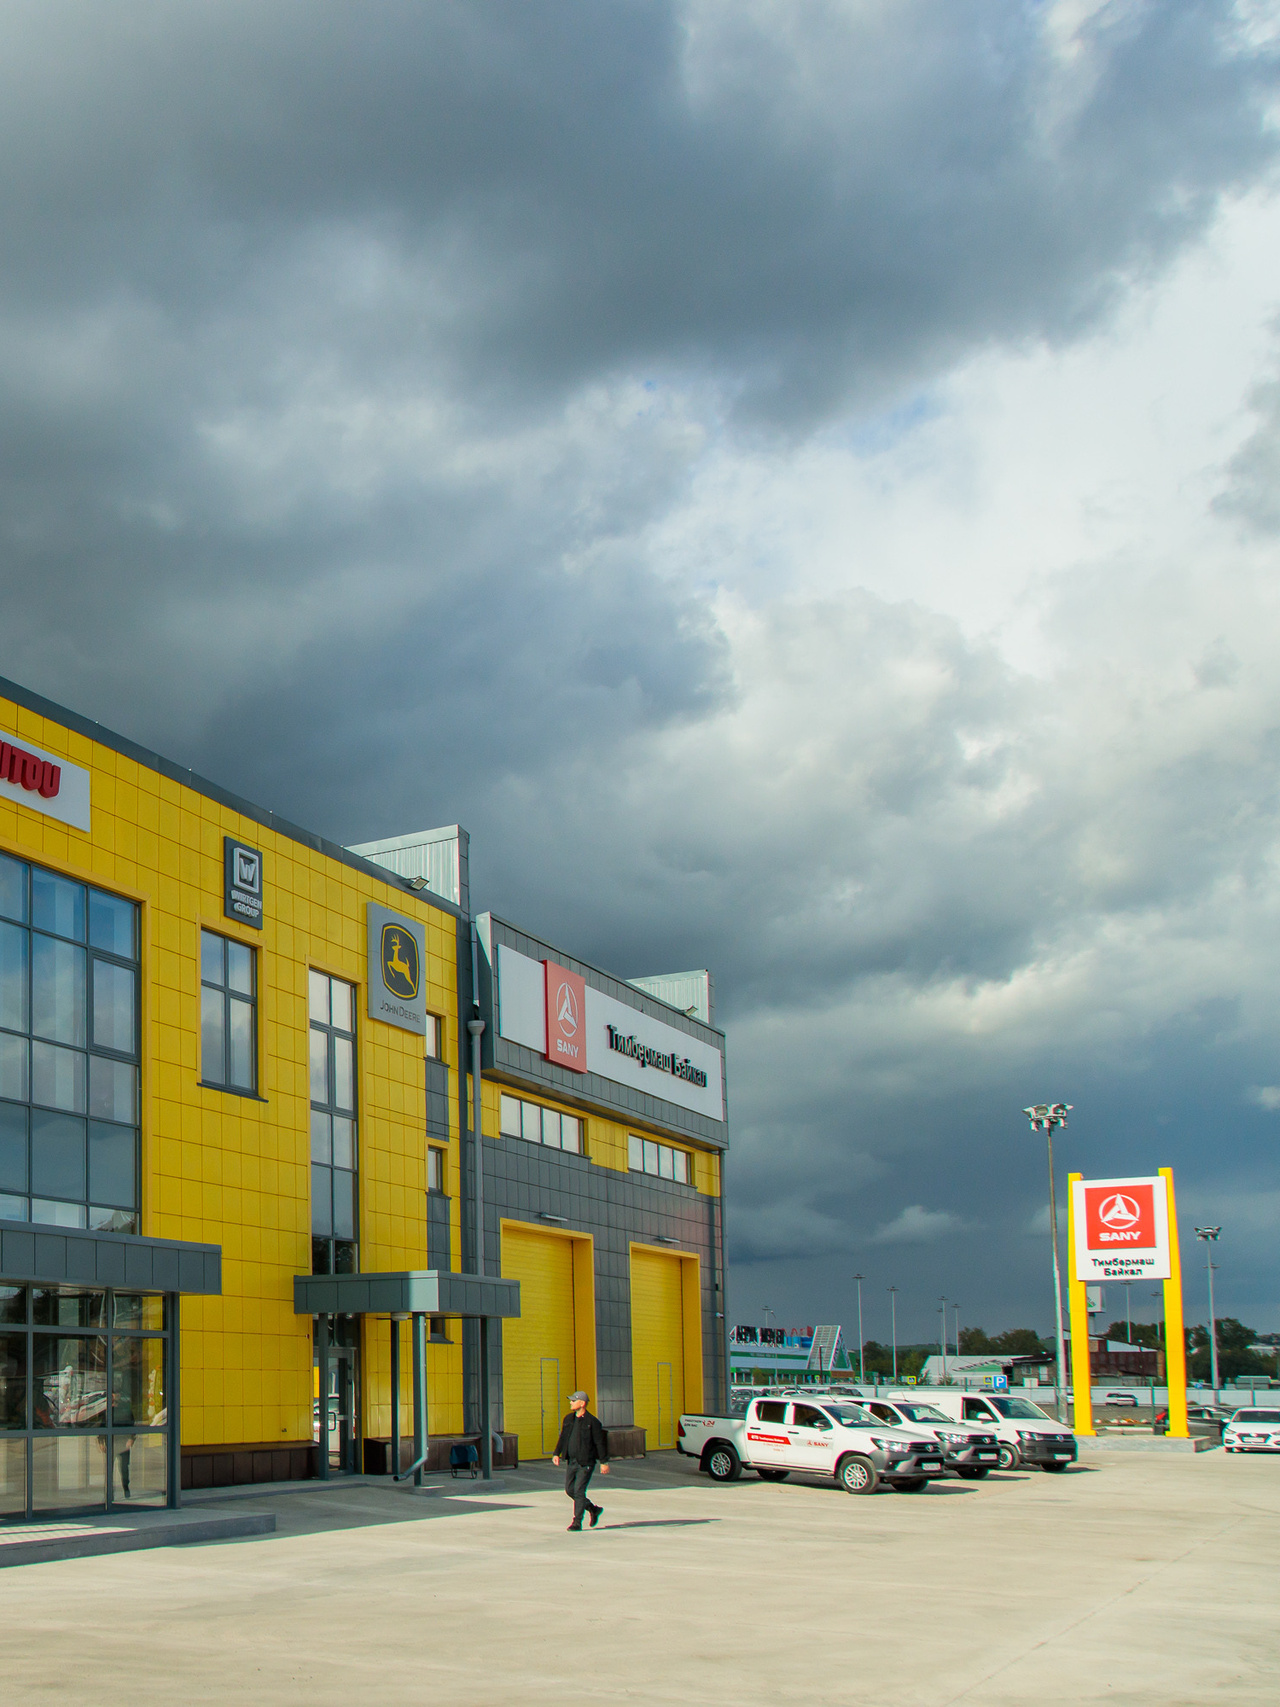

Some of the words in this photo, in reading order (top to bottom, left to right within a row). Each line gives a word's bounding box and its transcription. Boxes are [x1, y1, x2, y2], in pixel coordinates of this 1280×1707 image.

[231, 890, 262, 909] WIRTGEN
[234, 902, 260, 918] GROUP
[380, 1000, 399, 1016] JOHN
[400, 1006, 421, 1023] DEERE
[557, 1038, 579, 1058] SANY
[605, 1024, 671, 1072] Тимбермаш
[670, 1053, 708, 1088] Байкал
[1099, 1232, 1141, 1241] SANY
[1091, 1258, 1154, 1267] Тимбермаш
[1104, 1267, 1142, 1276] Байкал
[996, 1376, 1005, 1388] P
